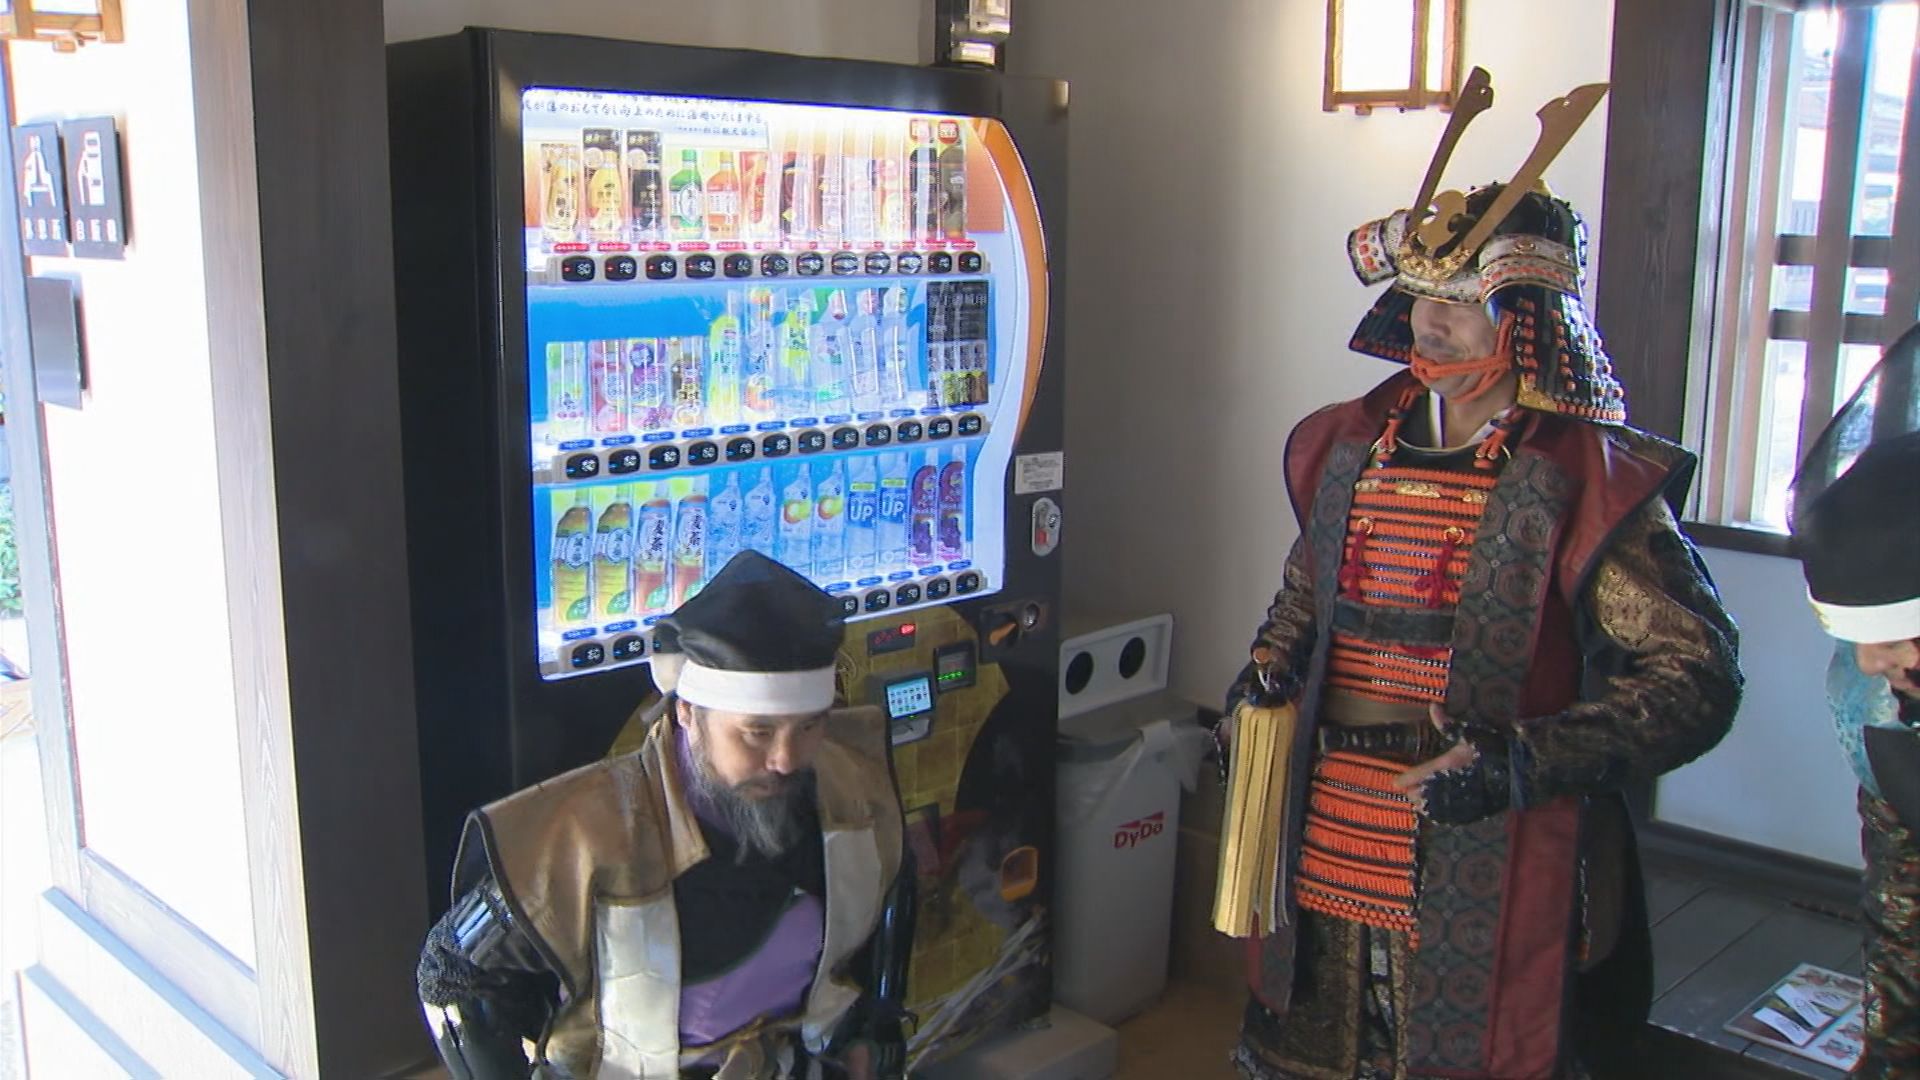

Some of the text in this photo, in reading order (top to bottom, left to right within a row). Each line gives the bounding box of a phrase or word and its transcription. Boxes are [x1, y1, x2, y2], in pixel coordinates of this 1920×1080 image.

[850, 503, 874, 522] UP
[881, 499, 905, 517] UP
[1113, 822, 1164, 849] DyDo
